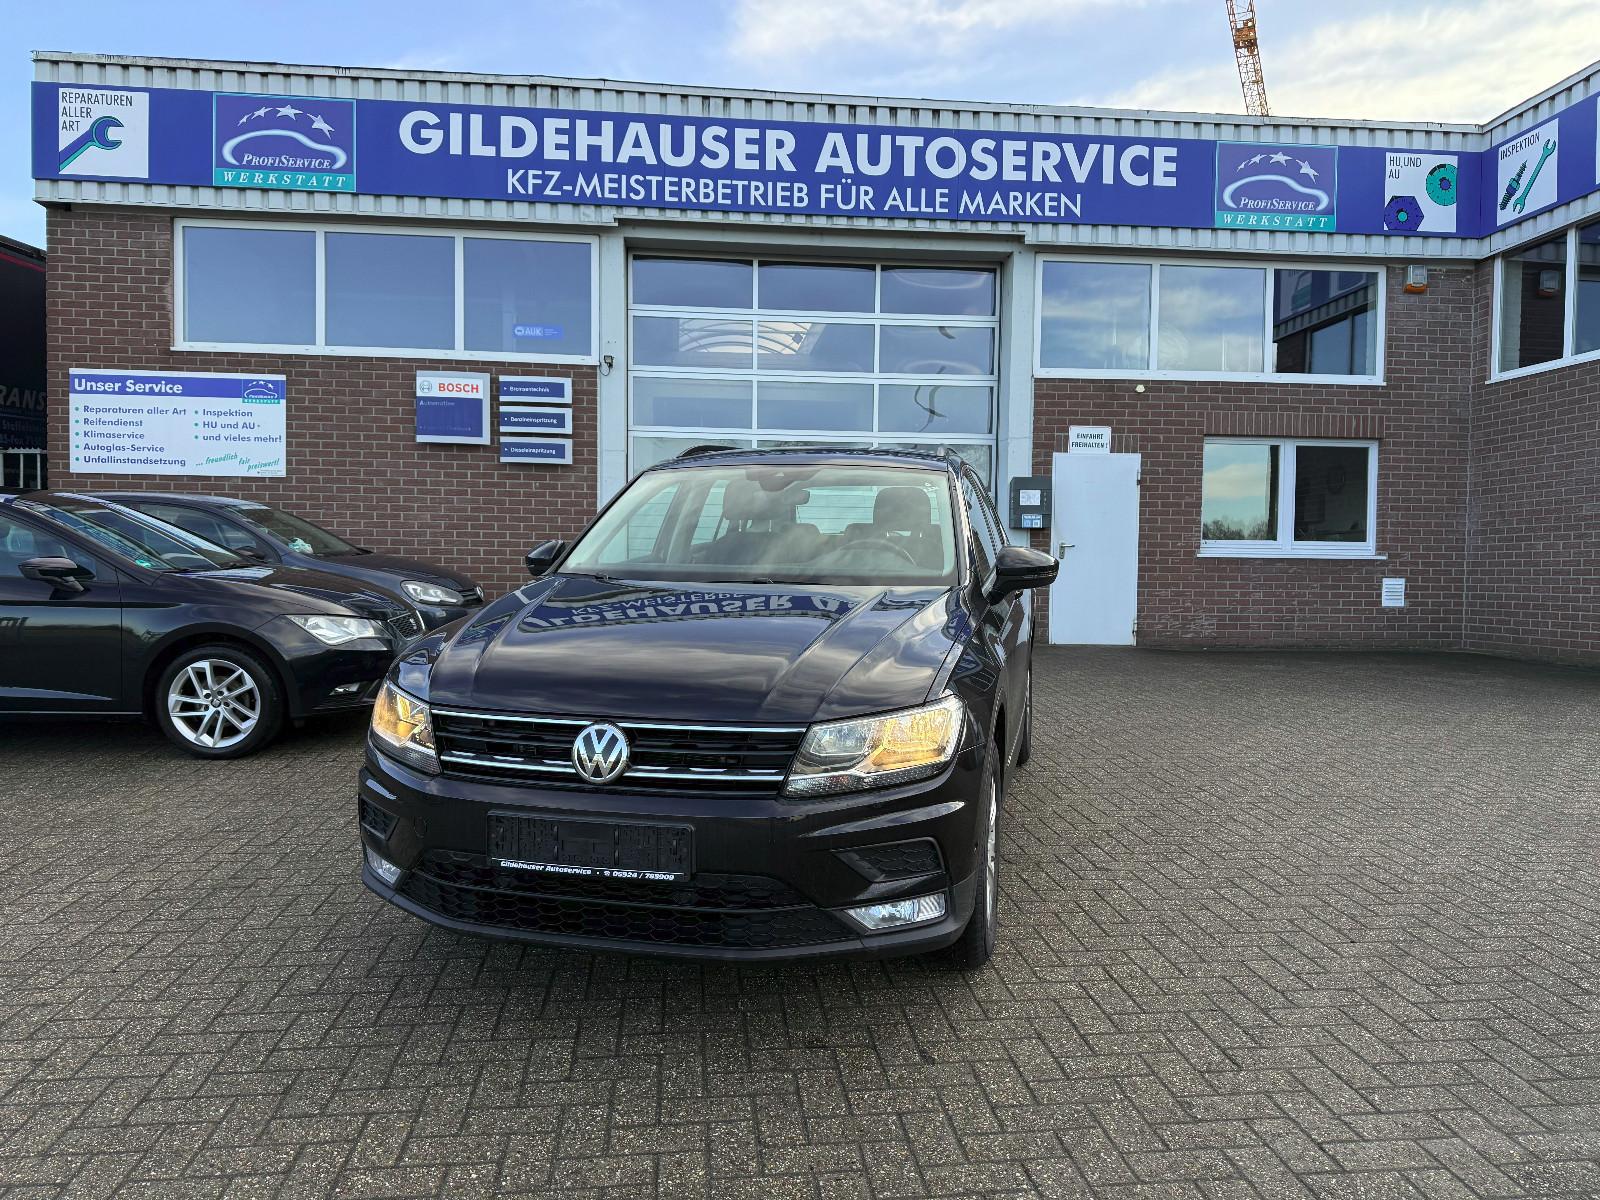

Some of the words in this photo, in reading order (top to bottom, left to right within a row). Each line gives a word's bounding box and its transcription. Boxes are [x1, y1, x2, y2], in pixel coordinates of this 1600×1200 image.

[61, 91, 133, 107] REPARATUREN
[61, 106, 92, 118] ALLER
[61, 120, 81, 131] ART
[399, 110, 797, 172] GILDEHAUSER
[814, 132, 1178, 187] AUTOSERVICE
[1500, 132, 1540, 160] INSPEKTION
[242, 153, 331, 169] PROFISERVICE
[1403, 157, 1422, 168] UND
[223, 171, 346, 187] WERKSTATT
[1388, 168, 1400, 179] AU
[507, 169, 809, 208] KFZ-MEISTERBETRIEB
[820, 179, 875, 211] FÜR
[884, 187, 949, 214] ALLE
[959, 190, 1081, 218] MARKEN
[1240, 197, 1316, 211] PROFISERVICE
[1223, 213, 1328, 228] WERKSTATT
[74, 378, 121, 392] Unser
[125, 379, 183, 394] Service
[438, 383, 479, 394] BOSCH
[83, 405, 144, 415] Reparaturen
[147, 406, 169, 415] aller
[172, 407, 186, 415] Art
[203, 409, 253, 418] Inspektion
[83, 418, 143, 427] Reifendienst
[203, 421, 217, 429] HU
[220, 421, 239, 429] und
[83, 430, 145, 440] Klimaservice
[224, 434, 252, 442] vieles
[254, 435, 282, 443] mehr!
[83, 443, 165, 453] Autoglas-Service
[83, 455, 186, 467] Unfallinstandsetzung
[205, 452, 238, 464] freundlich
[239, 457, 250, 466] fair
[247, 458, 280, 472] preiswert!
[500, 861, 544, 871] Gildehauser
[545, 865, 592, 875] Autoservice
